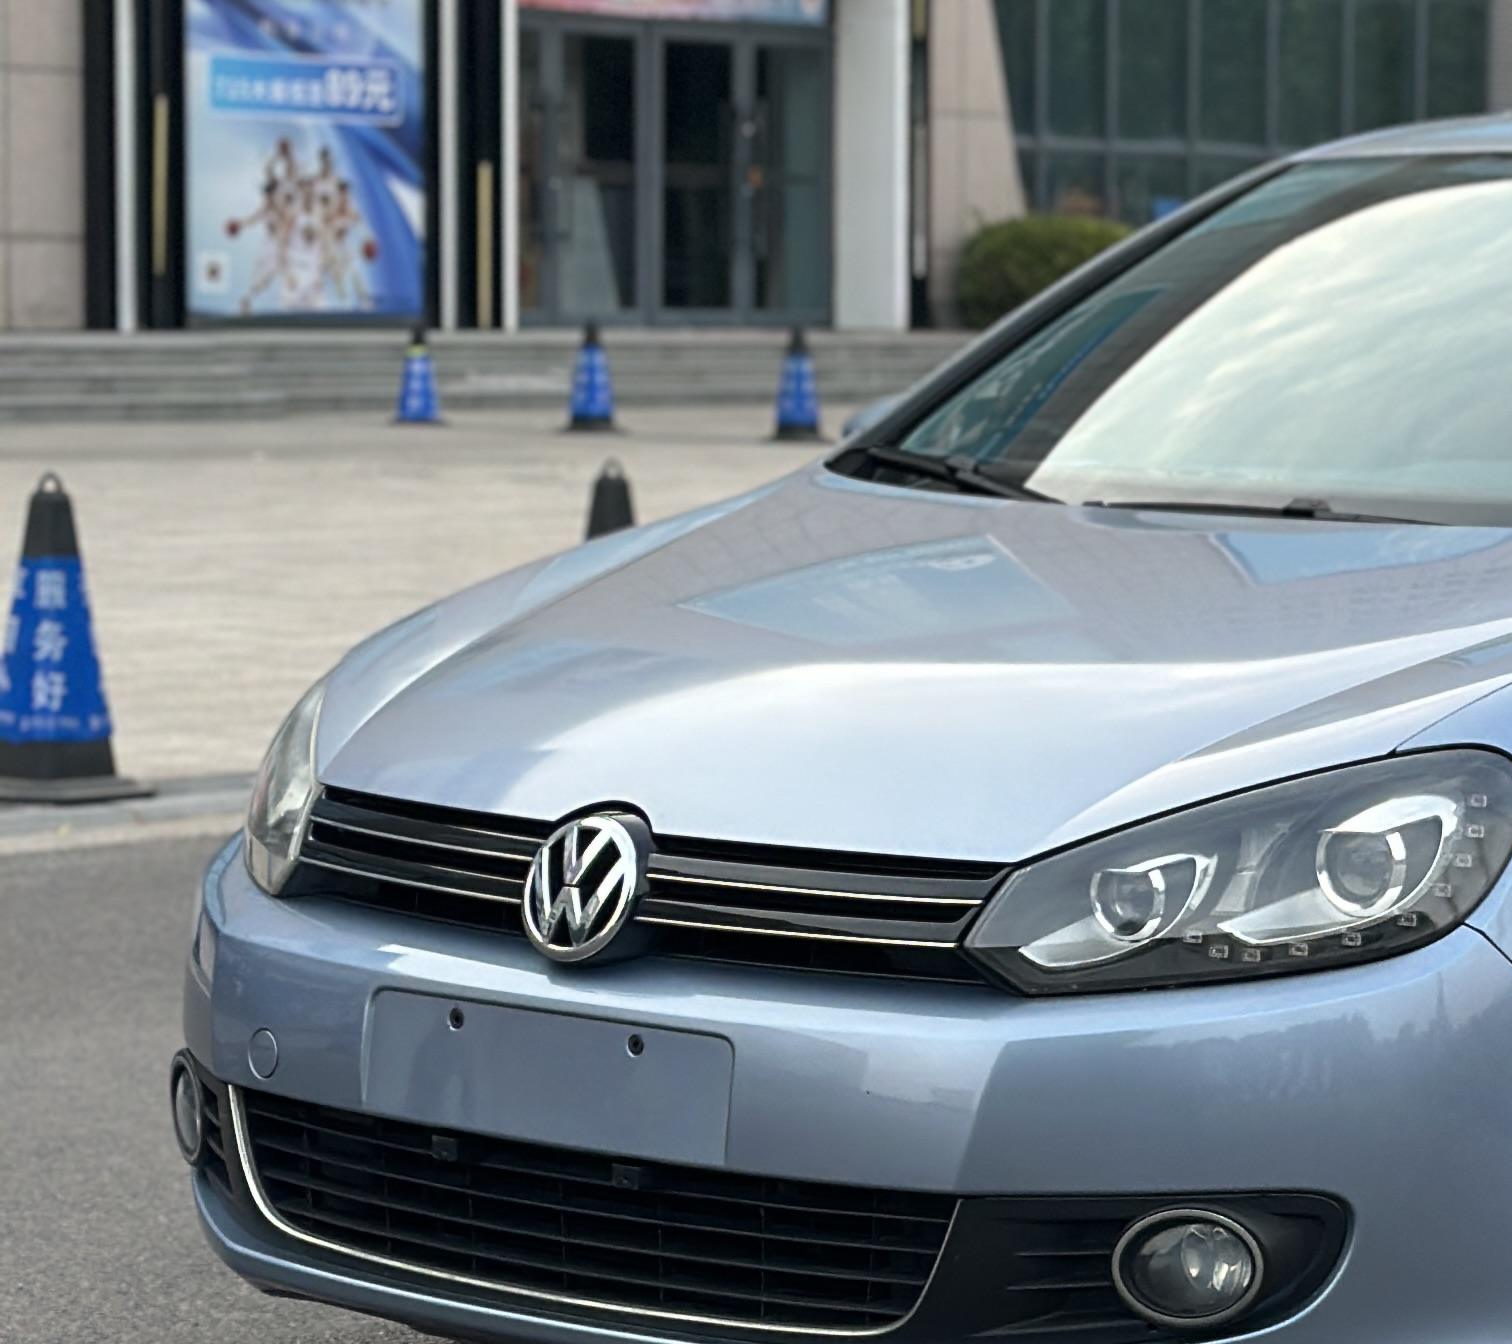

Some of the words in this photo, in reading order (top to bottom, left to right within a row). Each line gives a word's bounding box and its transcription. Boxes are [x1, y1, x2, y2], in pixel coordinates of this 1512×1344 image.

[32, 568, 69, 713] 服务好
[524, 817, 636, 960] VW
